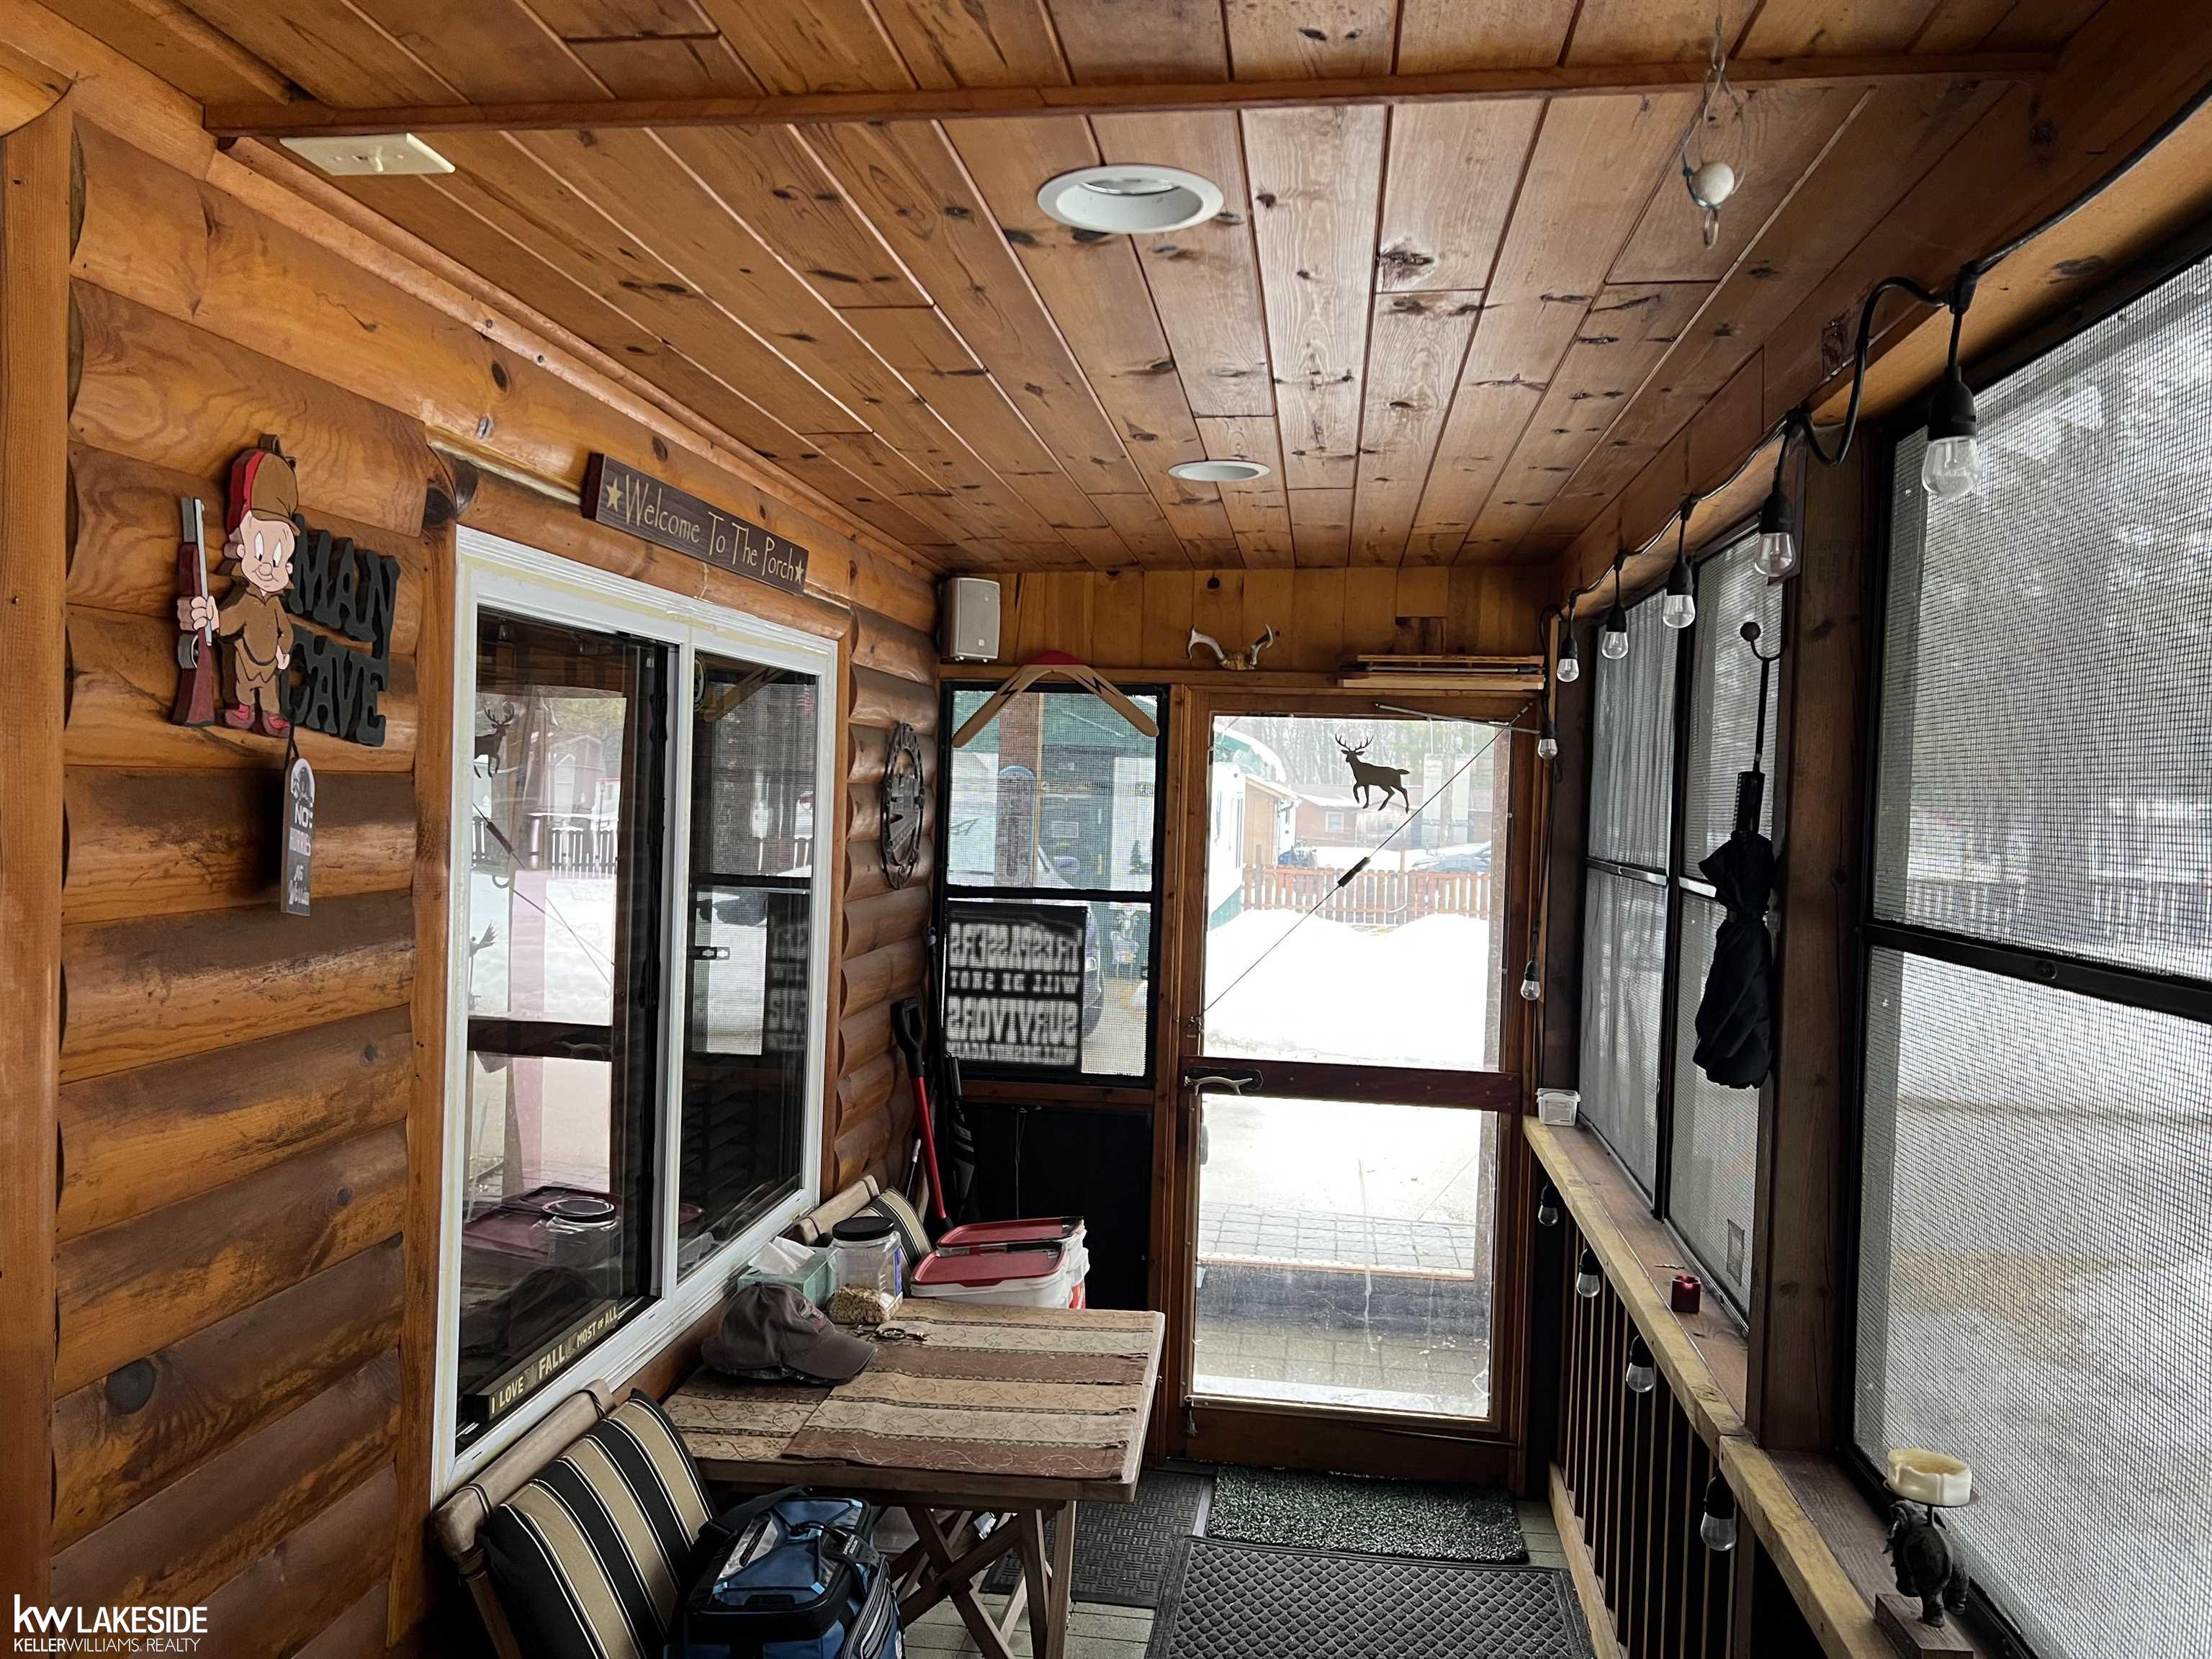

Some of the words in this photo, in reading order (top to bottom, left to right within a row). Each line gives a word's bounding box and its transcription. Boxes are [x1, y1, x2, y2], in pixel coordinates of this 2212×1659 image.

[288, 513, 401, 642] MAN
[625, 474, 700, 543] Welcome
[708, 511, 726, 556] To
[732, 522, 758, 566] The
[762, 536, 795, 582] Porch
[491, 1397, 495, 1414] I
[499, 1376, 523, 1408] LOVE
[539, 1344, 565, 1380] FALL
[577, 1321, 596, 1348] MOST
[597, 1321, 604, 1330] OF
[605, 1305, 618, 1326] ALL
